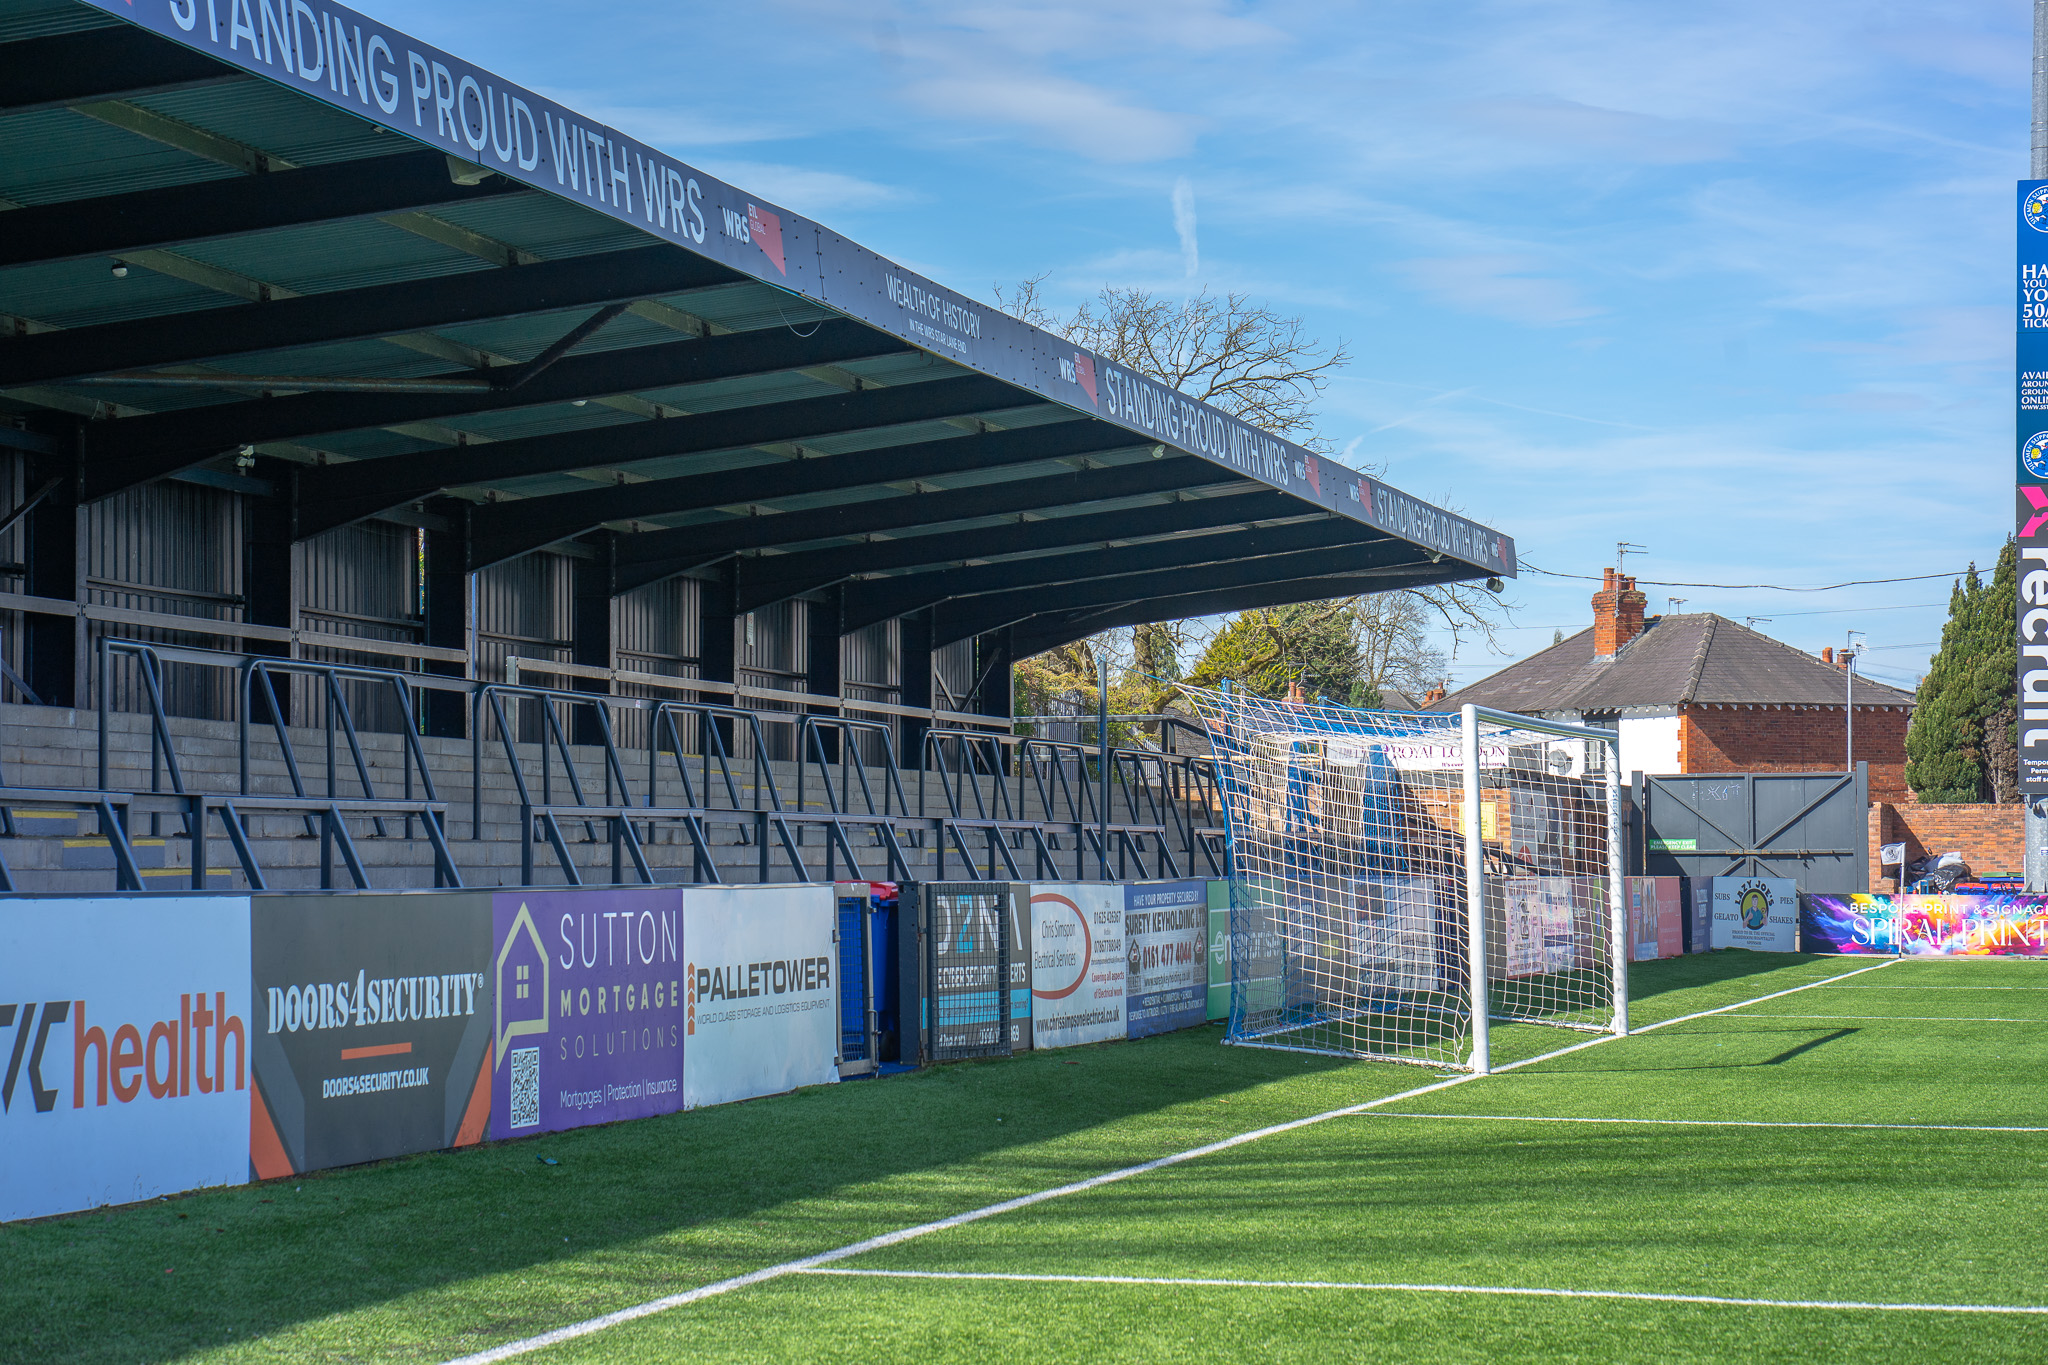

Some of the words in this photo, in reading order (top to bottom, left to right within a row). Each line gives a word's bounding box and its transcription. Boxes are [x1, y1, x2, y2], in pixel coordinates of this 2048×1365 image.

[170, 0, 399, 115] ANDING
[407, 50, 539, 172] PROUD
[544, 111, 633, 214] WITH
[635, 153, 706, 245] WRS
[722, 207, 749, 243] WRS
[885, 273, 927, 316] WEALTH
[928, 293, 940, 322] OF
[942, 300, 980, 339] HISTORY
[915, 320, 924, 336] THE
[935, 329, 946, 345] STAR
[1059, 357, 1076, 384] WRS
[1105, 366, 1179, 440] STANDING
[1180, 400, 1226, 459] PROUD
[1227, 421, 1261, 475] WITH
[1260, 436, 1288, 486] WRS
[1377, 487, 1421, 539] STANDING
[1422, 507, 1450, 550] PROUD
[1450, 518, 1472, 558] WITH
[1470, 526, 1488, 564] WRS
[1442, 746, 1505, 758] LOON
[1157, 892, 1176, 904] PROPERTY
[1176, 890, 1194, 903] SECURED
[1714, 892, 1730, 901] SUBS
[1734, 880, 1752, 906] LAZY
[1755, 880, 1774, 906] JOE'S
[1780, 896, 1794, 904] PIES
[1125, 911, 1151, 936] SURETY
[1153, 908, 1195, 932] KEYHOLDING
[1714, 912, 1739, 921] GELATO
[1769, 916, 1794, 924] SHAKES
[1850, 903, 1919, 914] BESPOKE
[1924, 903, 1968, 914] PRINT
[1973, 904, 1982, 915] &
[559, 910, 677, 970] SUTTON
[1042, 920, 1054, 938] Chris
[1851, 917, 1952, 945] SPIRAL
[1035, 949, 1056, 969] Electrical
[1056, 949, 1076, 968] Services
[1143, 945, 1159, 970] 0161
[1161, 943, 1174, 966] 477
[1176, 940, 1192, 965] 4044
[697, 957, 830, 1003] PALLETOWER
[560, 980, 678, 1018] MORTGAGE
[697, 1012, 718, 1025] WORLD
[718, 1010, 736, 1023] CLASS
[737, 1007, 761, 1020] STORAGE
[762, 1005, 773, 1016] AND
[774, 1002, 800, 1015] LOGISTICS
[800, 998, 830, 1011] EQUIPMENT
[73, 991, 246, 1109] health
[560, 1025, 678, 1060] SOLUTIONS
[322, 1067, 430, 1099] DOORS4SECURITY.CO.UK
[560, 1090, 602, 1110] Mortgages
[607, 1081, 641, 1101] Protection
[646, 1079, 677, 1095] Insurance
